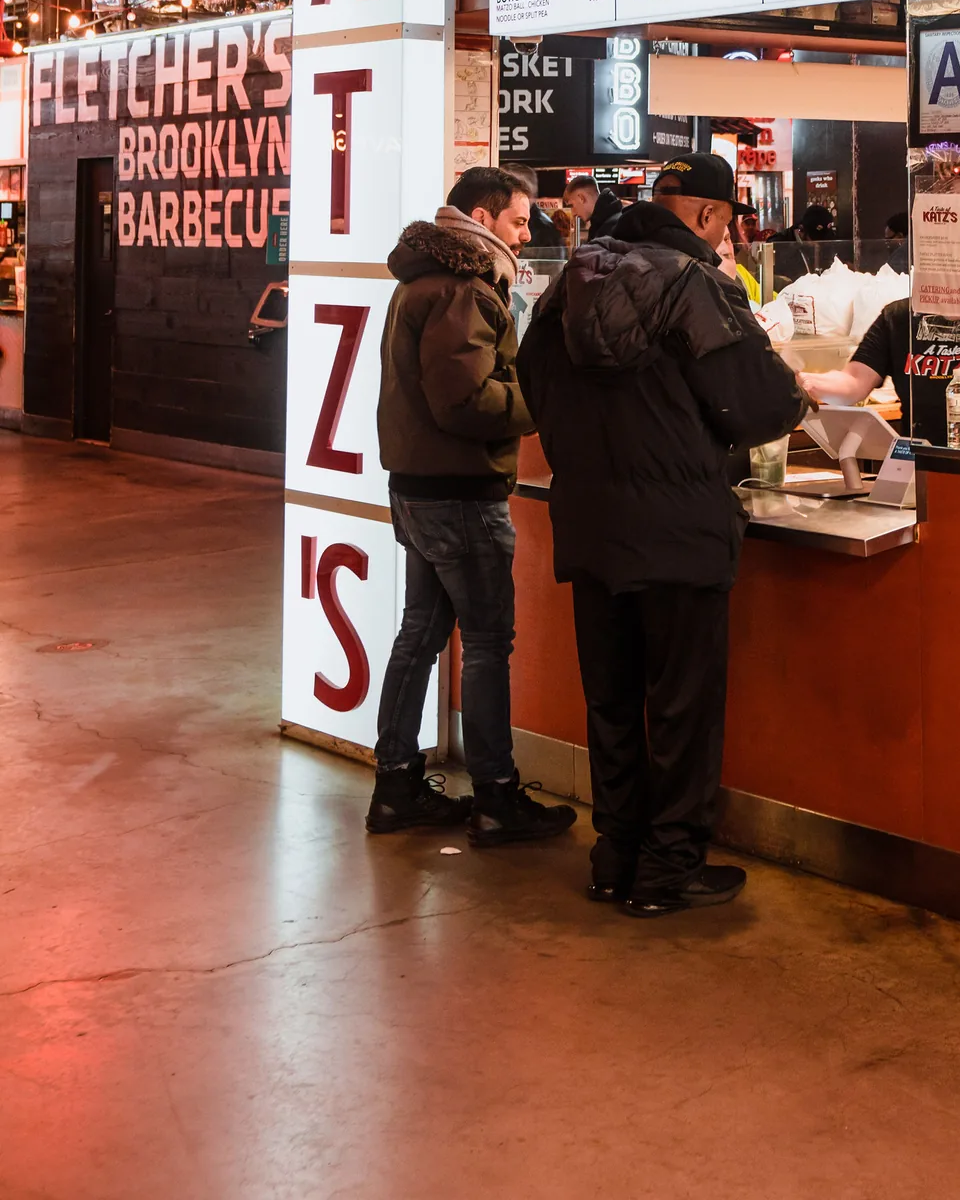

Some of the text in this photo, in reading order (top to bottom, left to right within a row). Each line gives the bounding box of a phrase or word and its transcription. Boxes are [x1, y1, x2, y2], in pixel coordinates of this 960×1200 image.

[528, 0, 549, 8] CHICKEN
[496, 14, 516, 22] NOODLE
[33, 18, 291, 127] FLETCHER'S
[119, 115, 290, 181] BROOKLYN
[923, 211, 958, 222] KATZ'S
[920, 285, 949, 294] CATERING
[924, 344, 935, 355] A
[936, 345, 960, 356] Taste
